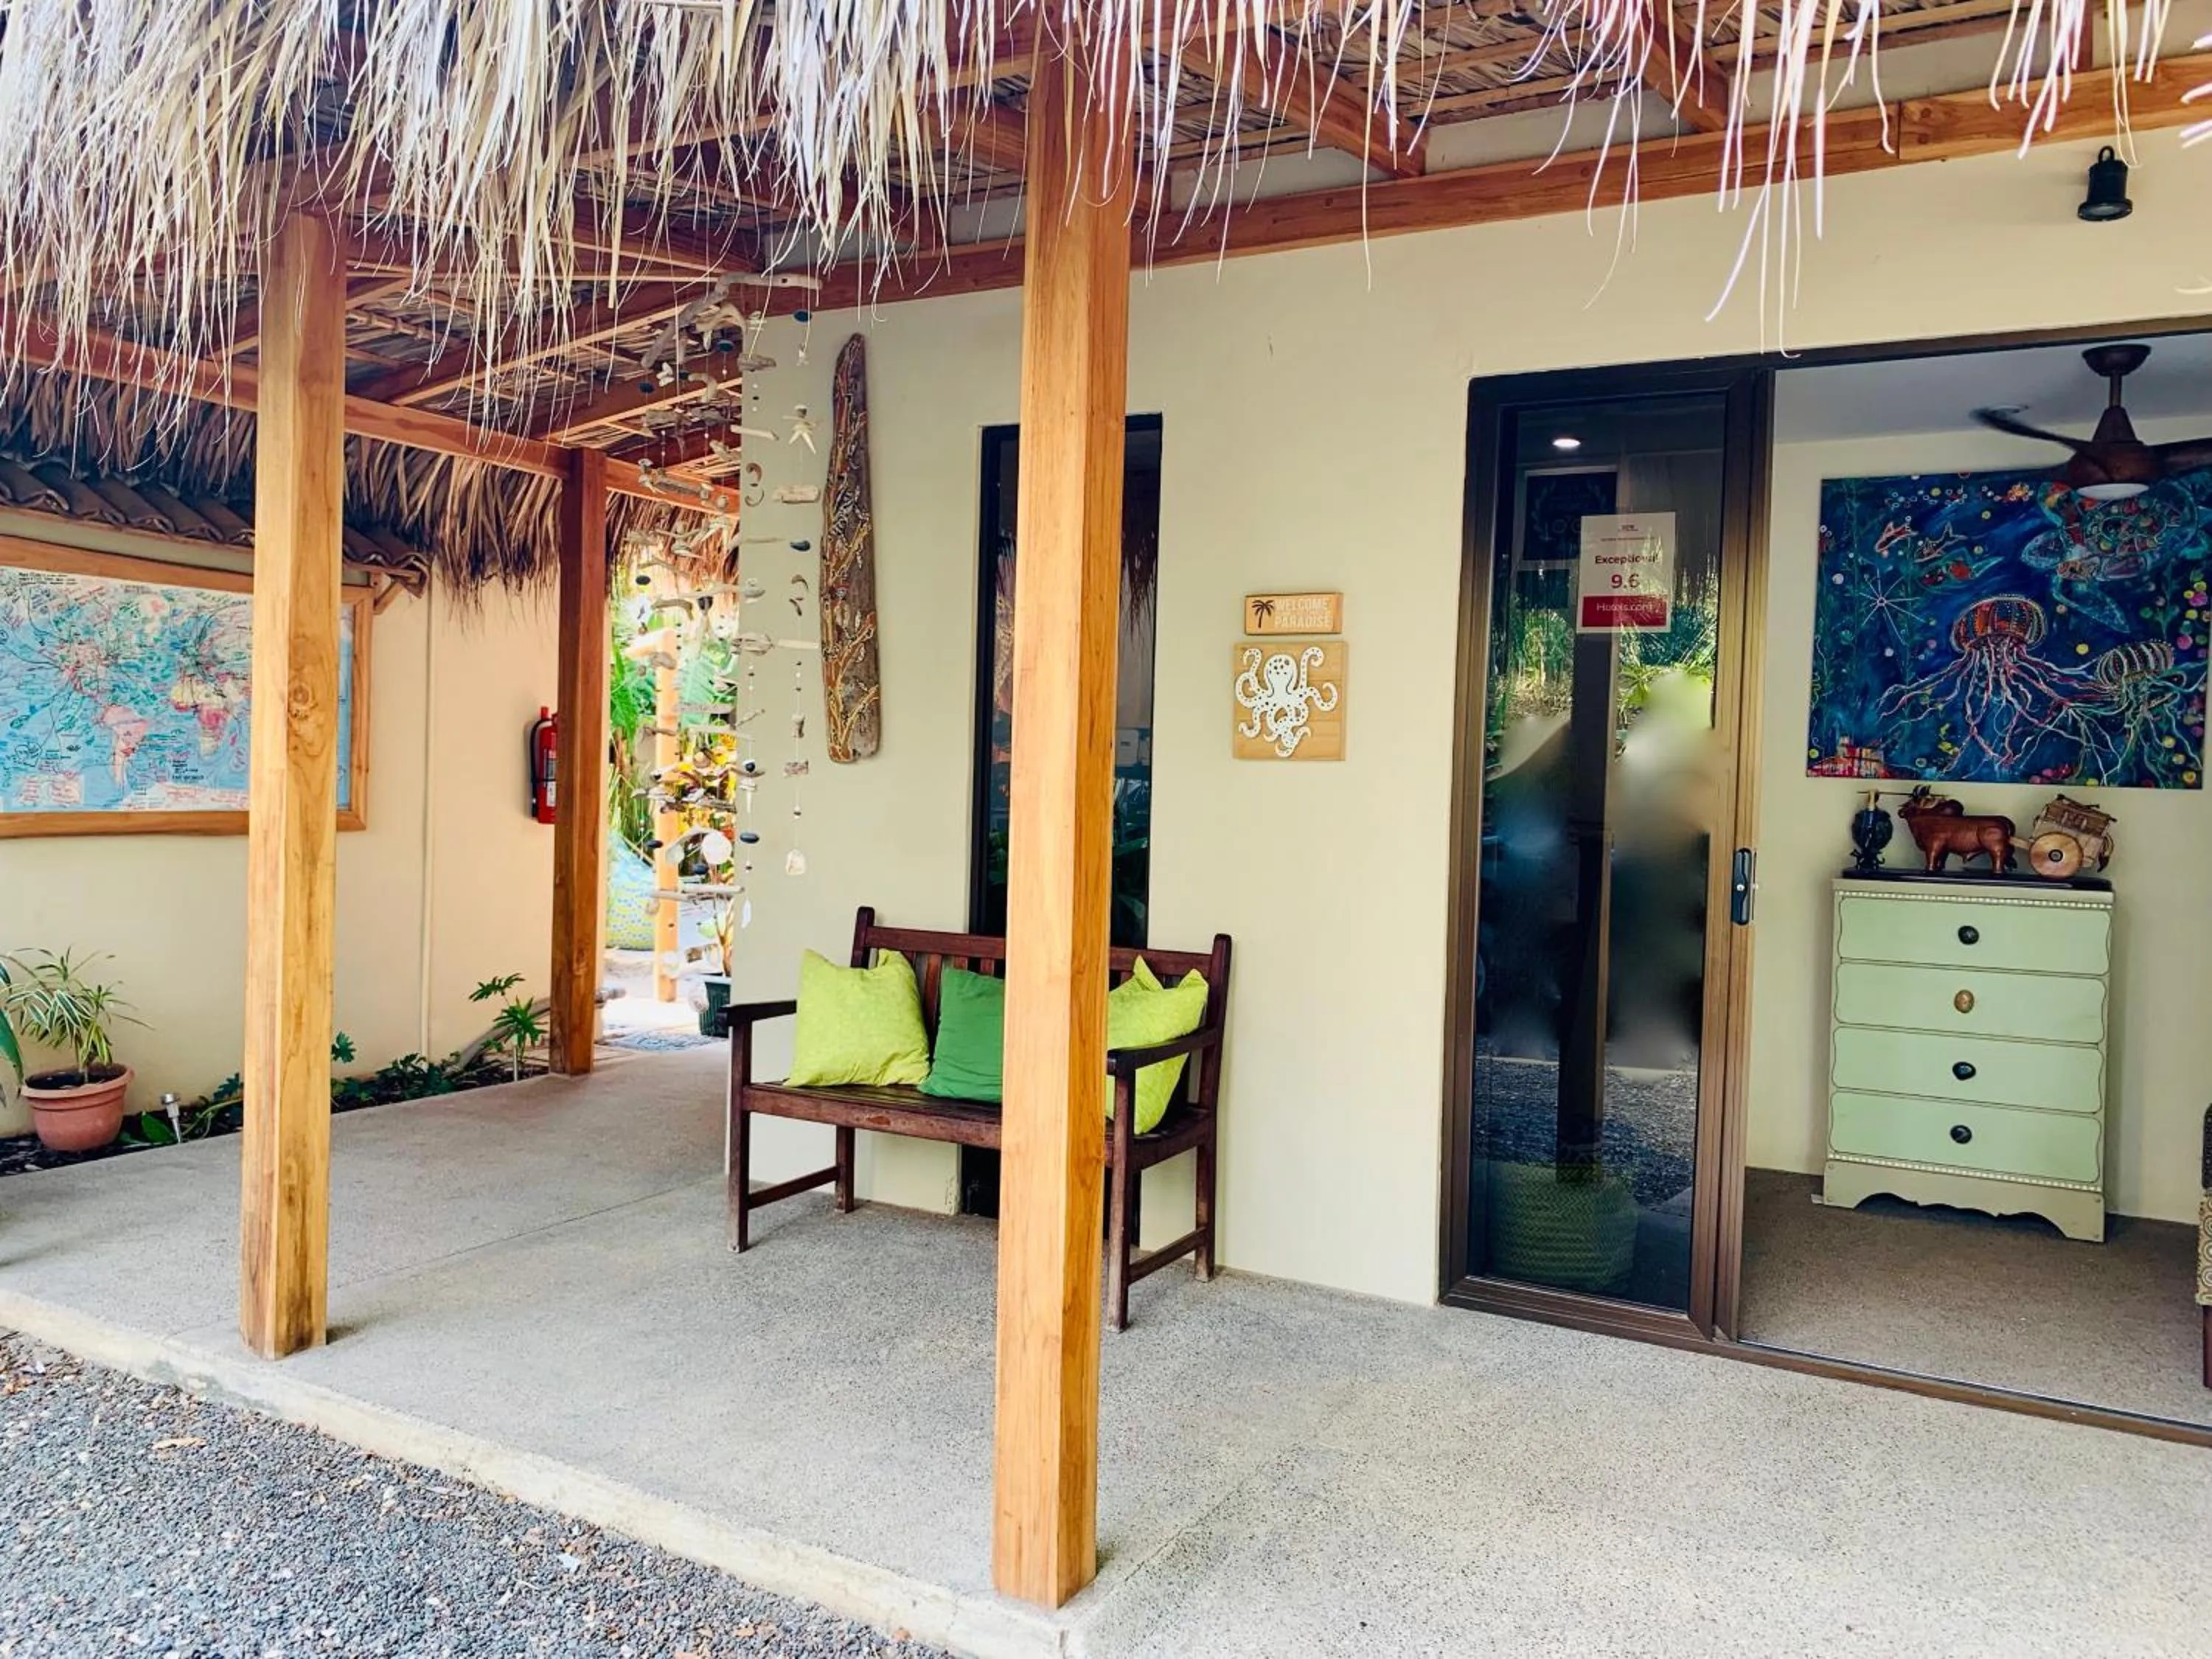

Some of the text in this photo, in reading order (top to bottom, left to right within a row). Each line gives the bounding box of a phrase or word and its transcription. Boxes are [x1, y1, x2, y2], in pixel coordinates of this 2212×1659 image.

[1611, 573, 1640, 589] 9.6
[1275, 598, 1329, 611] WELCOME
[1275, 615, 1333, 628] PARADISE
